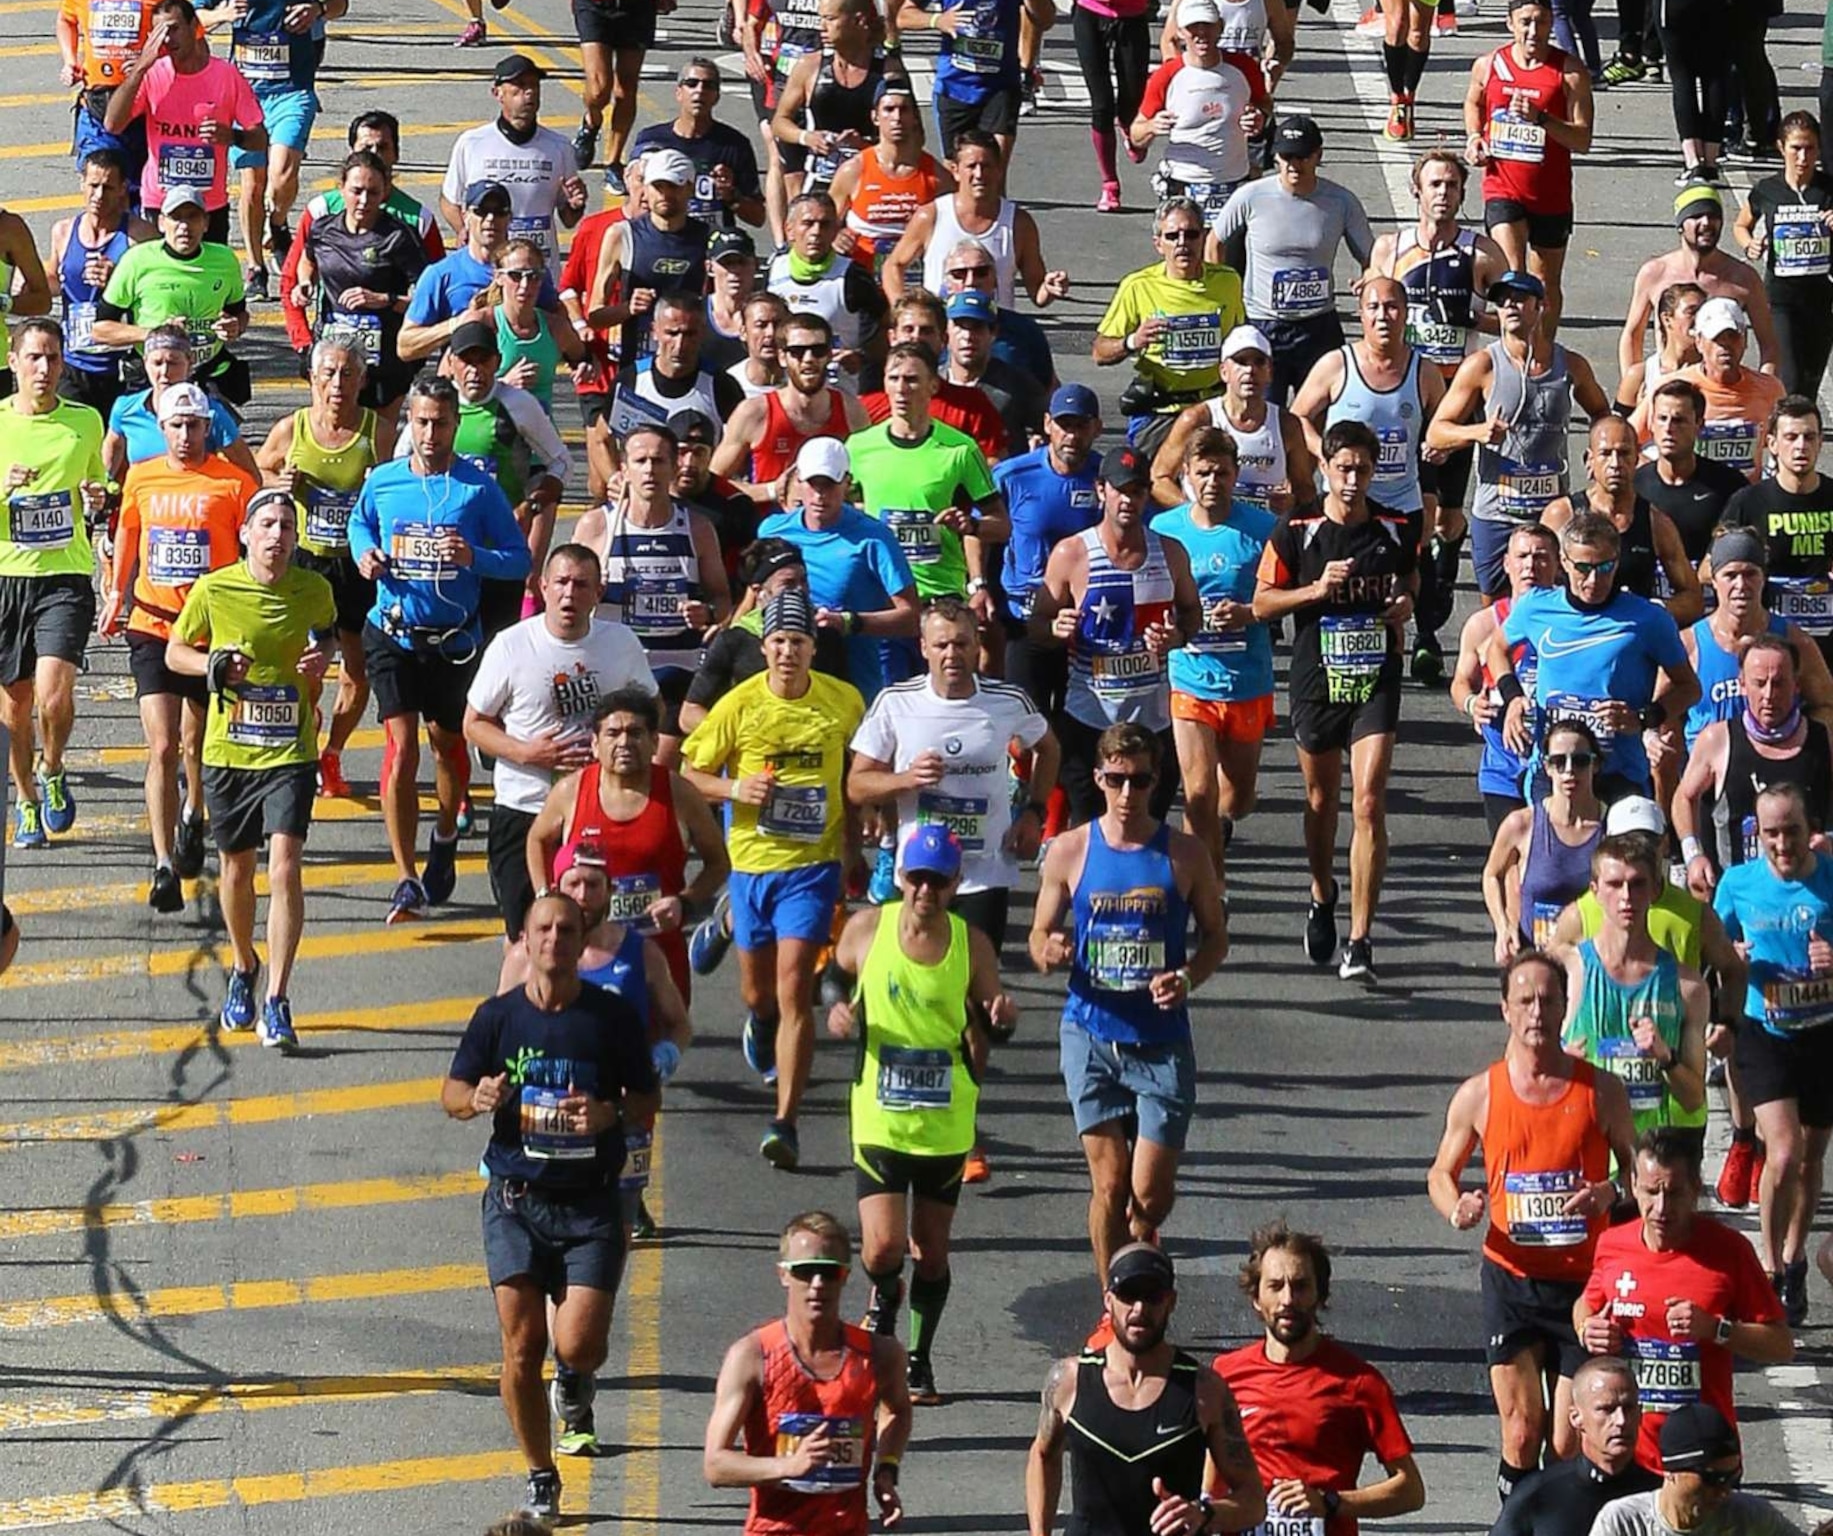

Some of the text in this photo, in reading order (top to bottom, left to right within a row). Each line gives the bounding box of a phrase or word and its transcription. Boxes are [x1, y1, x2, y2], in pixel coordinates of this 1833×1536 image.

[1507, 127, 1538, 144] 14135
[174, 158, 208, 177] 8949
[1175, 330, 1217, 348] 15570
[1713, 441, 1752, 459] 15757
[1518, 476, 1553, 495] 12415
[150, 493, 210, 518] MIKE
[31, 506, 64, 527] 4140
[1768, 512, 1833, 537] PUNIS
[1791, 535, 1826, 556] ME
[645, 596, 678, 614] 4199
[1789, 598, 1827, 614] 9635
[1110, 654, 1151, 675] 11002
[553, 677, 598, 700] BIG
[249, 703, 293, 724] 13050
